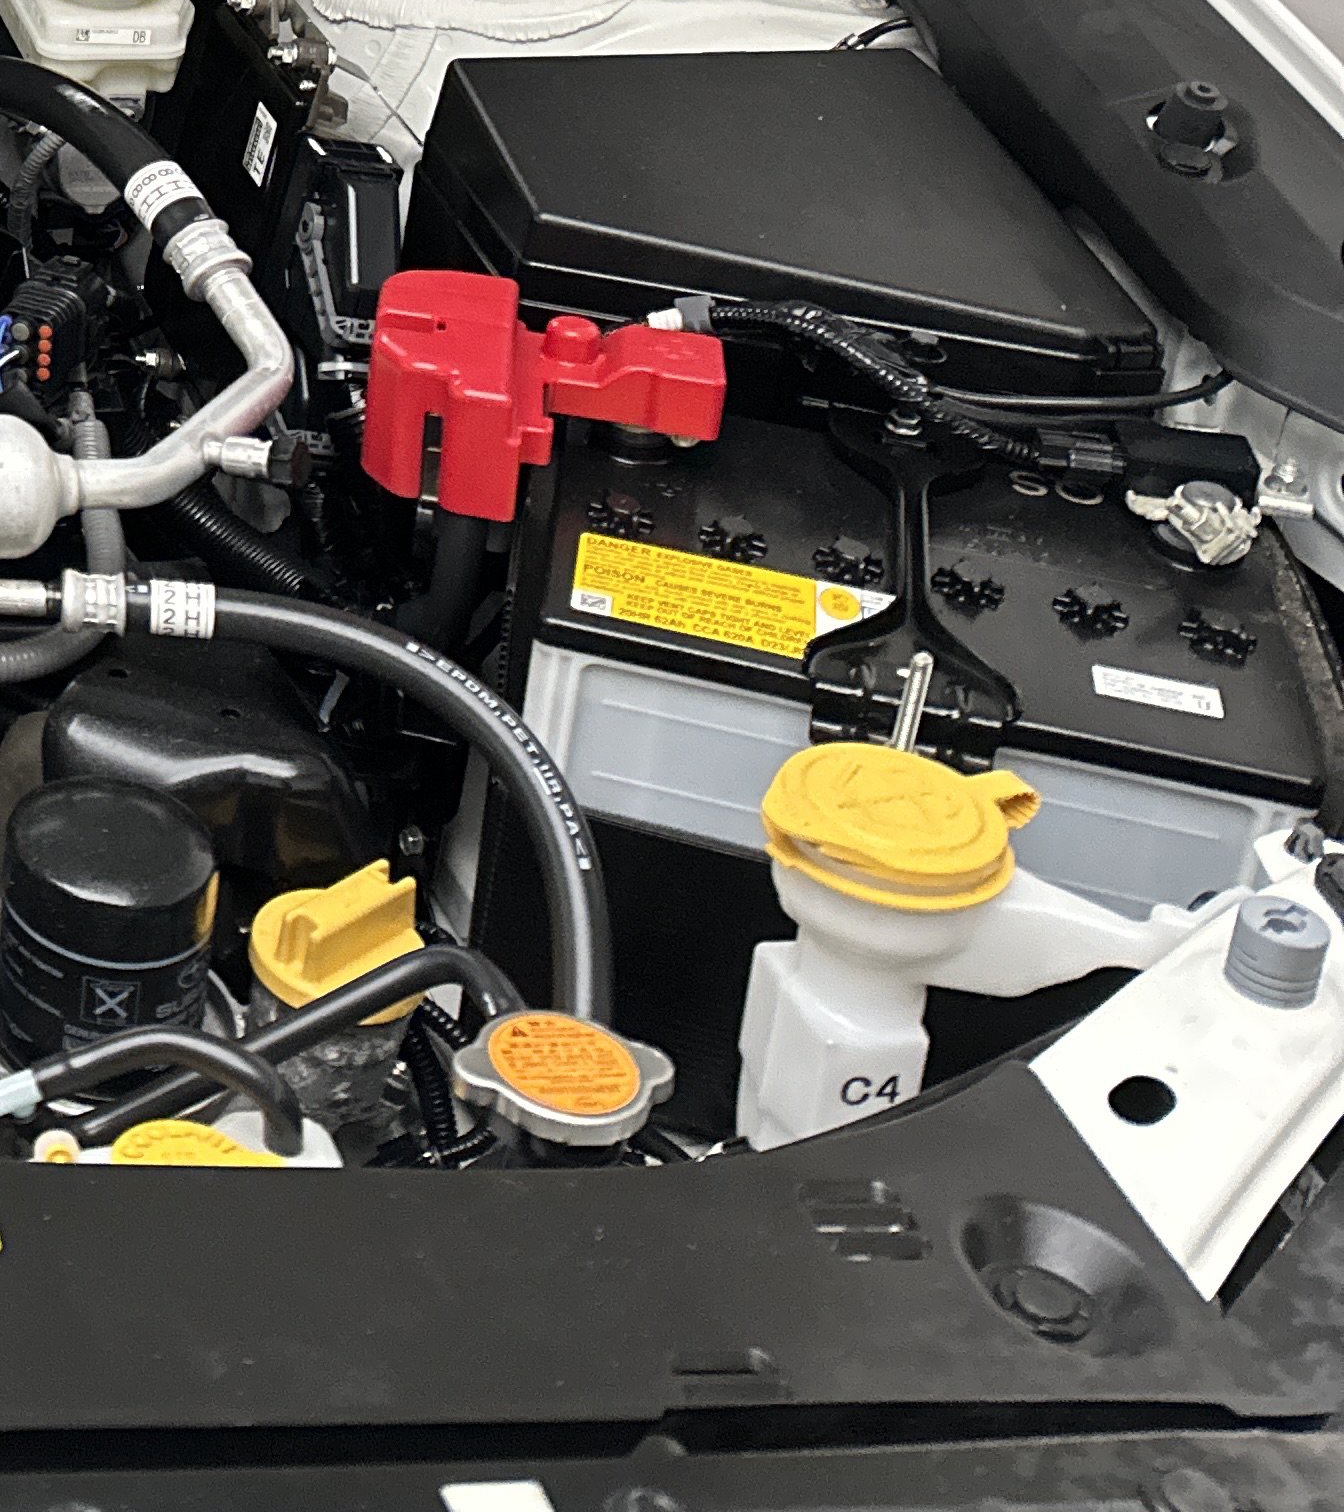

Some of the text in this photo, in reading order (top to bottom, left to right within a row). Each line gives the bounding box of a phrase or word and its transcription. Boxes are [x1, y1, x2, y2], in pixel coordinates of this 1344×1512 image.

[132, 30, 147, 43] DB
[586, 537, 651, 556] DANGER
[583, 563, 645, 583] POISON
[692, 623, 720, 636] CCA
[841, 1071, 900, 1106] C4
